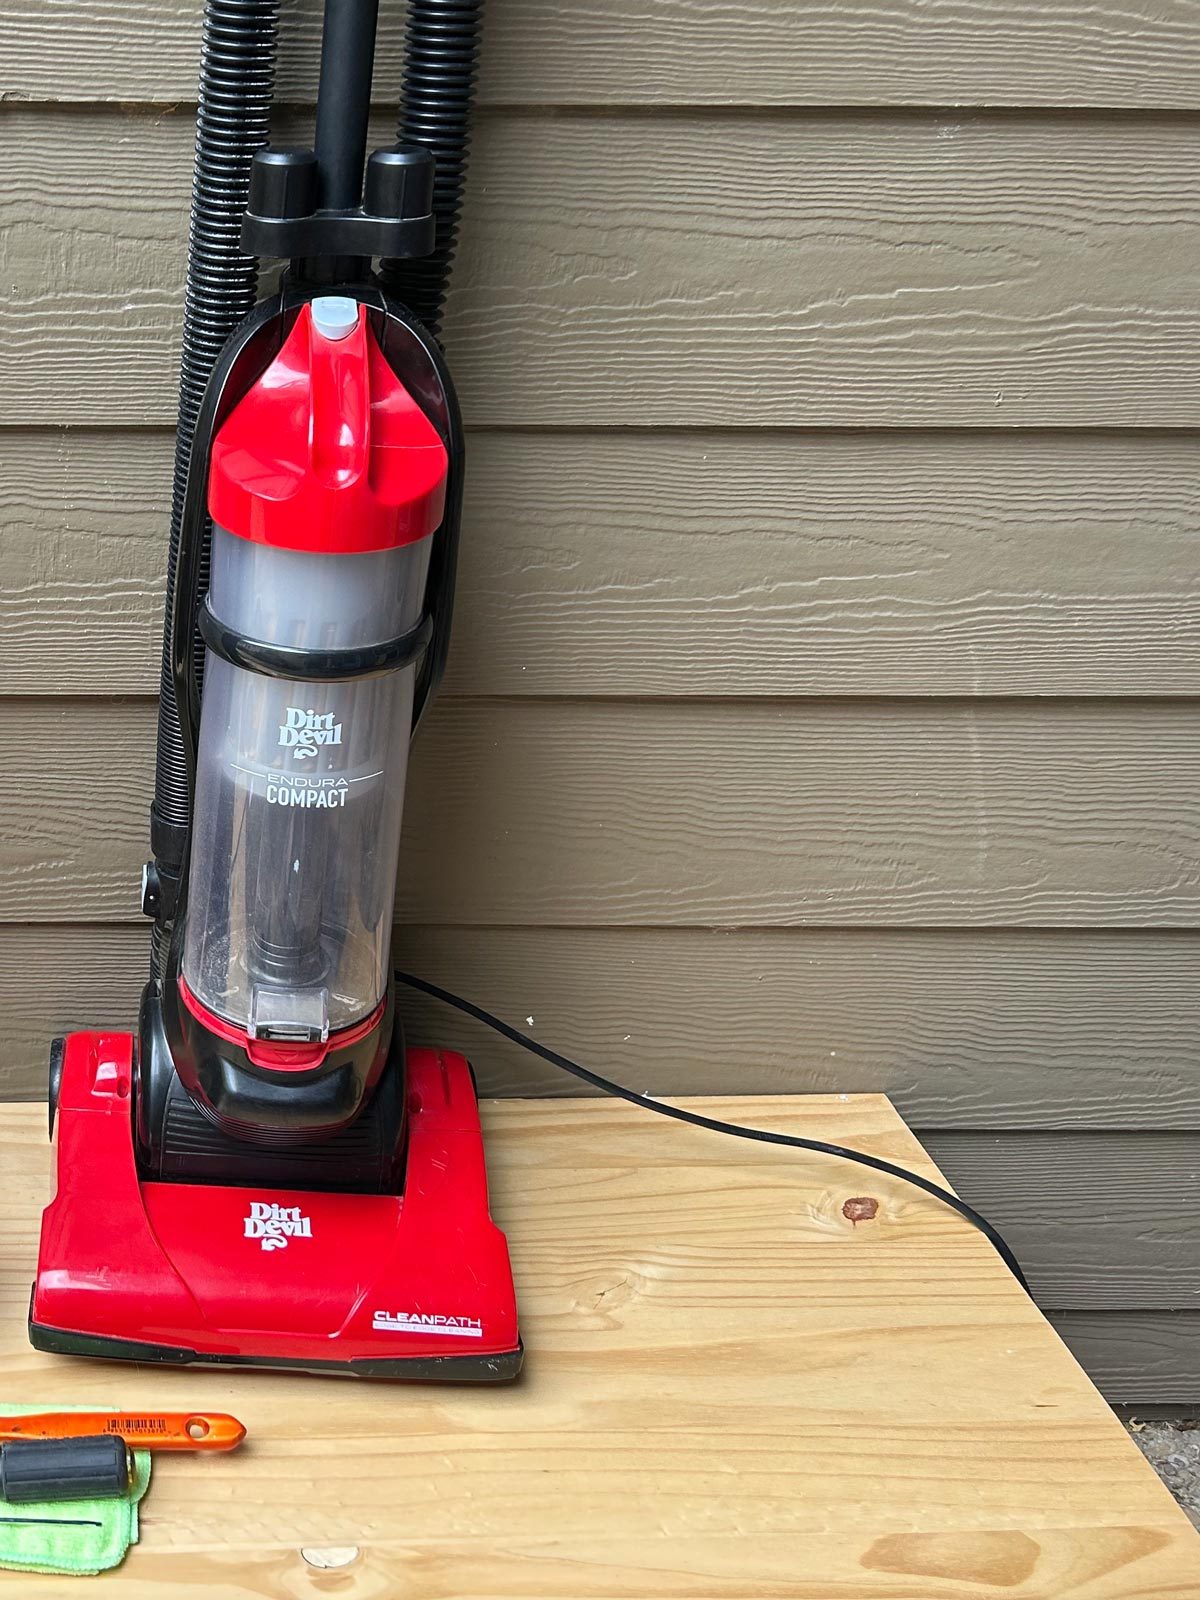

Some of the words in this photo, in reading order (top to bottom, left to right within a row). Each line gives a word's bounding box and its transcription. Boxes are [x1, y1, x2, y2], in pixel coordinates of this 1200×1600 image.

[285, 707, 335, 730] Dirt
[278, 723, 342, 747] Devil
[267, 773, 348, 788] ENDURA
[266, 784, 348, 808] COMPACT
[249, 1202, 302, 1221] Dirt
[243, 1217, 313, 1238] Devil
[374, 1310, 481, 1328] CLEANPATH
